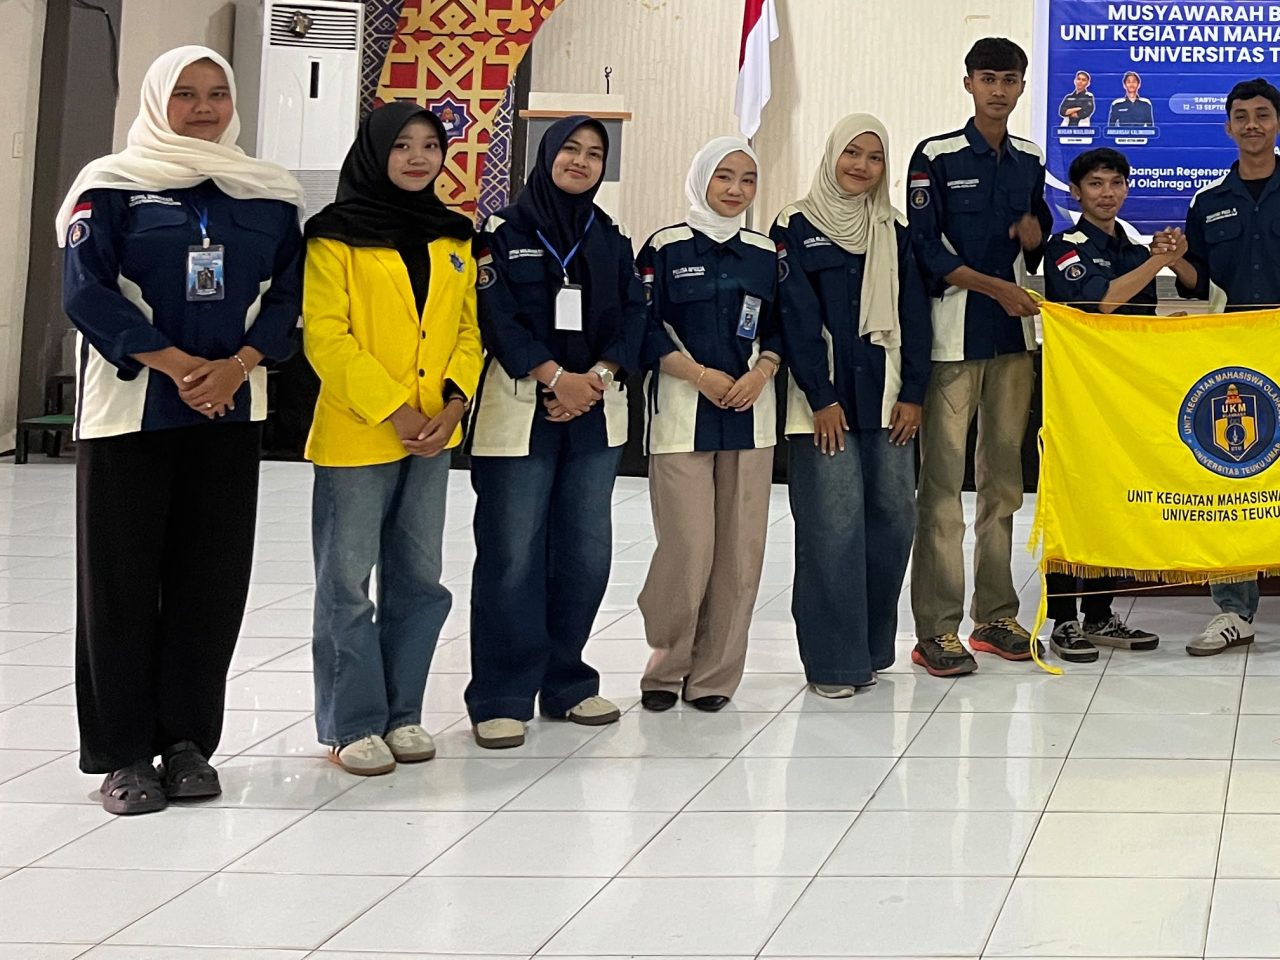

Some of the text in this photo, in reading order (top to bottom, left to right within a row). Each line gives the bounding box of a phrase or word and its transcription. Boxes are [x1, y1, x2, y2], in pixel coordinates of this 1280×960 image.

[1107, 4, 1264, 22] MUSYAWARAH
[1060, 24, 1109, 41] UNIT
[1113, 25, 1219, 43] KEGIATAN
[1129, 45, 1265, 63] UNIVERSITAS
[1129, 166, 1175, 179] bangun
[1176, 167, 1231, 179] Regenera
[1137, 178, 1192, 191] Olahraga
[1185, 377, 1216, 414] KEGIATAN
[1214, 371, 1264, 387] MAHASISWA
[1221, 403, 1247, 414] UKM
[1241, 460, 1266, 475] TEUKU
[1127, 489, 1154, 503] UNIT
[1156, 491, 1214, 507] KEGIATAN
[1162, 508, 1238, 522] UNIVERSITAS
[1241, 505, 1280, 521] TEUKU
